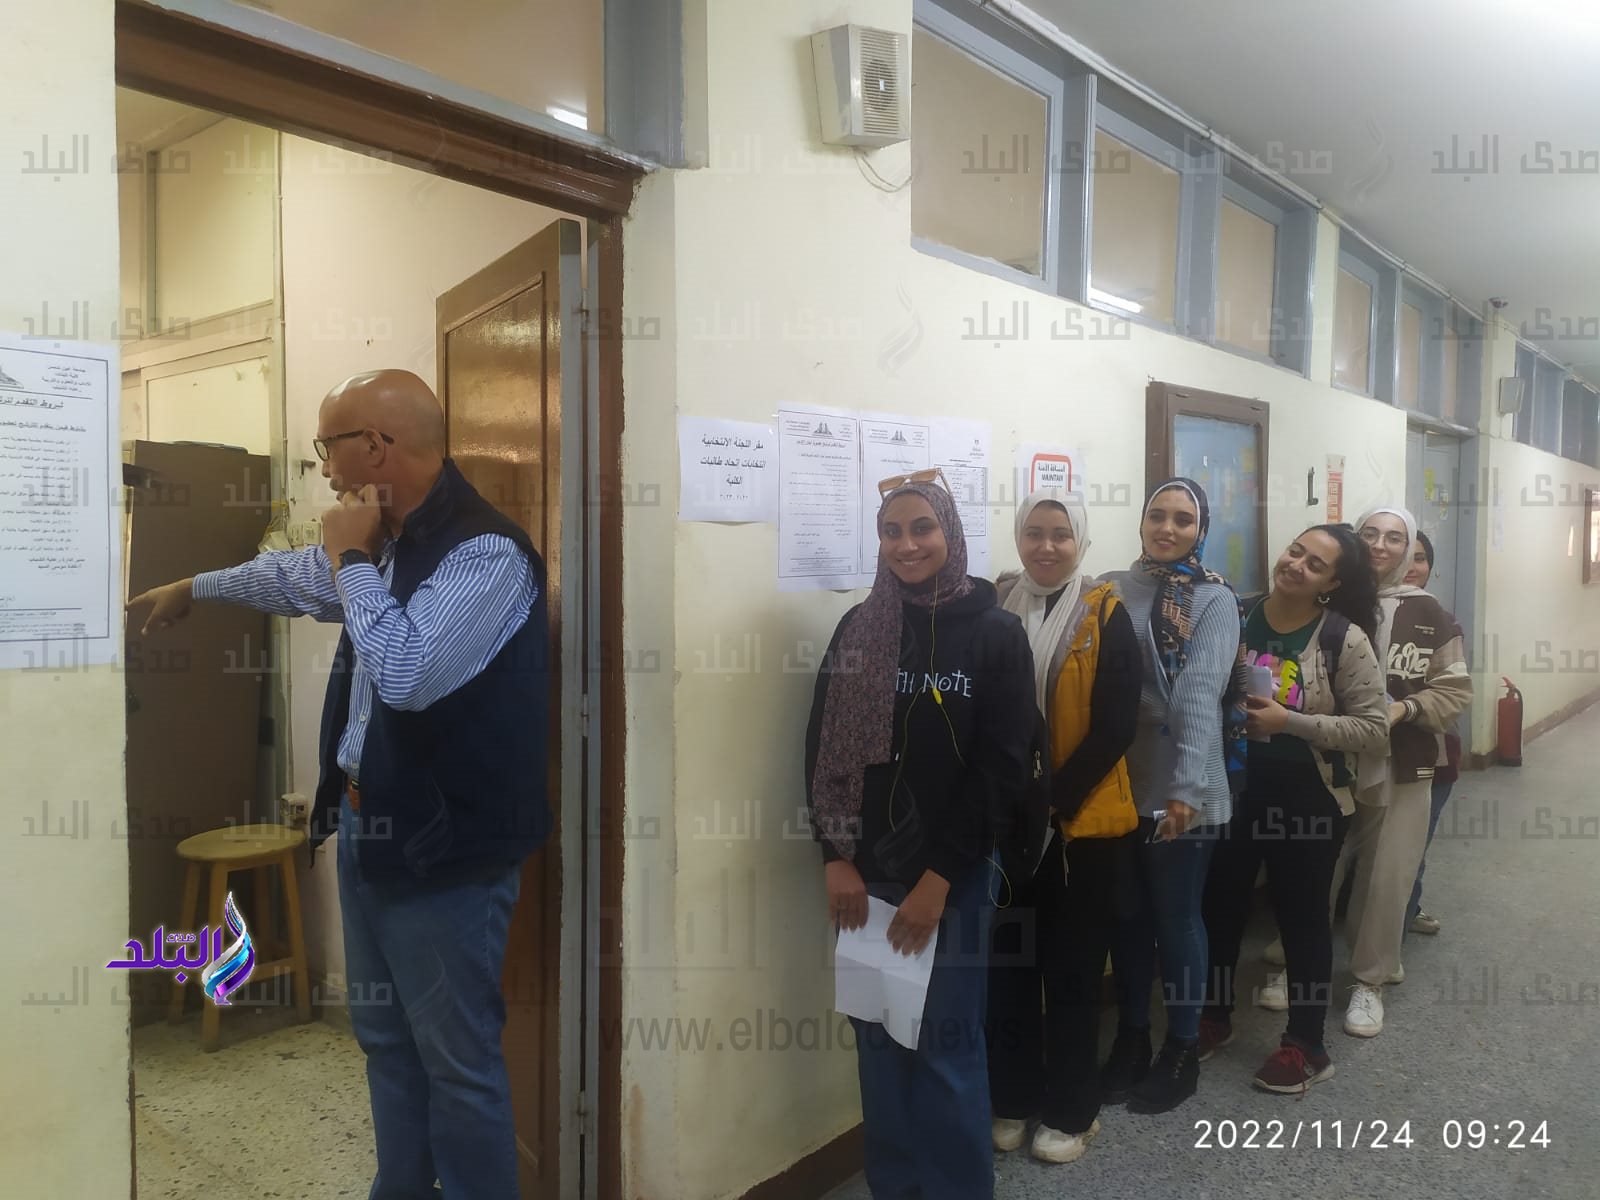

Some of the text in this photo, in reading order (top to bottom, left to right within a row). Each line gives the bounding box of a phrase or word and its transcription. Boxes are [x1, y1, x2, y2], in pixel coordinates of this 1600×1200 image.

[40, 400, 64, 410] شروط
[701, 434, 732, 448] الانتخابية
[734, 436, 751, 450] اللجنة
[700, 456, 722, 466] طالبات
[726, 474, 742, 486] الكلية
